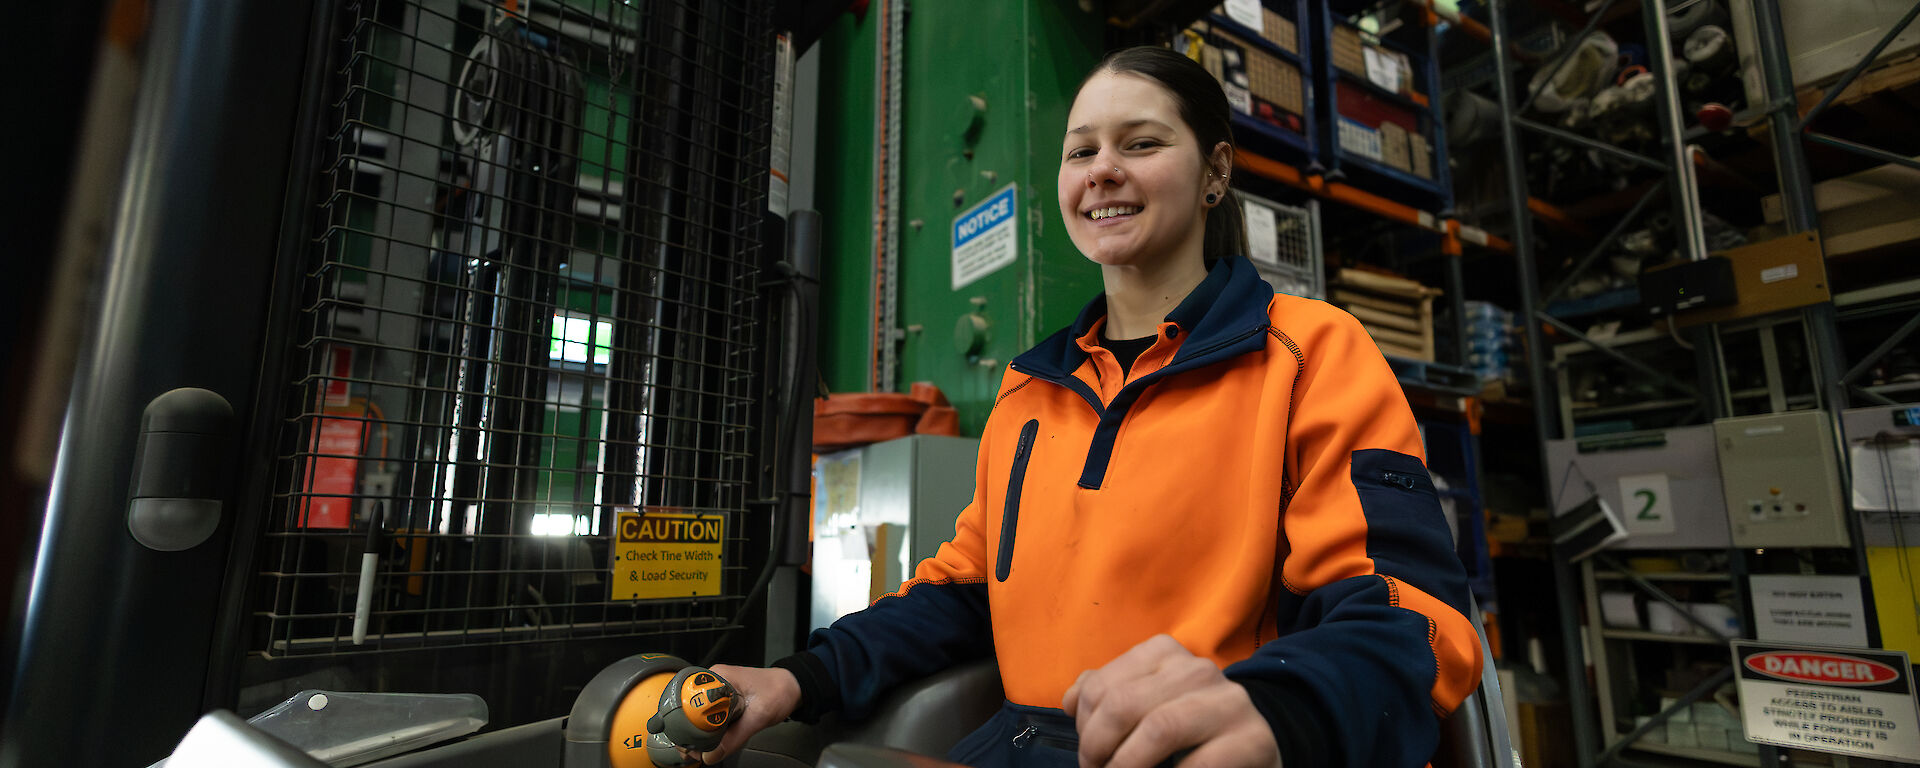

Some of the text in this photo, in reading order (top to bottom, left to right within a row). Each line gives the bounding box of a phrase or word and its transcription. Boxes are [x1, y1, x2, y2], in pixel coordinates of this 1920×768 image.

[958, 197, 1009, 240] NOTICE
[1633, 489, 1660, 520] 2
[622, 518, 719, 541] CAUTION
[625, 550, 714, 561] Check Tine Width
[629, 570, 709, 583] & Load Security
[1764, 656, 1875, 681] DANGER
[1770, 697, 1884, 717] ACCESS TO AISLES
[1785, 688, 1862, 703] PEDESTRIAN
[1762, 706, 1897, 731] STRICTLY PROHIBITED
[1773, 718, 1888, 741] WHILE FORKLIFT IS
[1788, 732, 1875, 750] IN OPERATION
